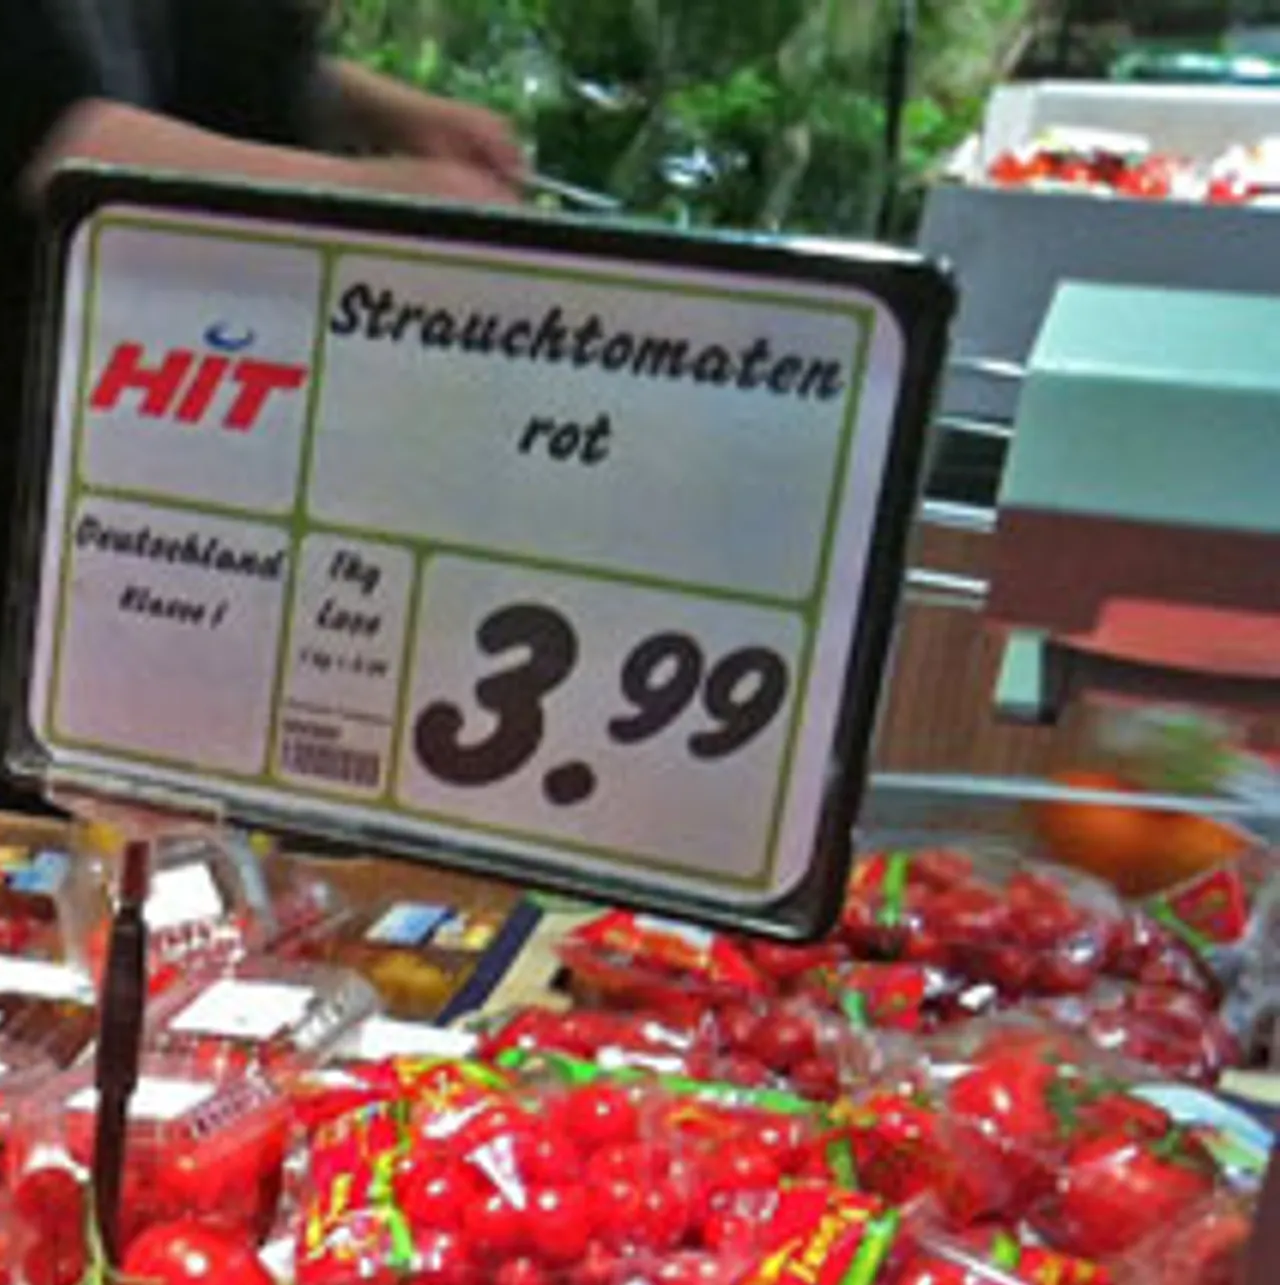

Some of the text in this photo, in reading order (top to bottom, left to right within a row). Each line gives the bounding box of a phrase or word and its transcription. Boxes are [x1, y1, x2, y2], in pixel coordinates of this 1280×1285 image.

[329, 281, 844, 403] Strauchtomaten
[89, 342, 307, 433] HIT
[517, 411, 613, 466] rot
[76, 513, 285, 580] Deutschland
[329, 549, 383, 596] 1kg
[118, 585, 207, 627] Klasse
[316, 597, 382, 637] Lose
[413, 602, 788, 806] 3.99
